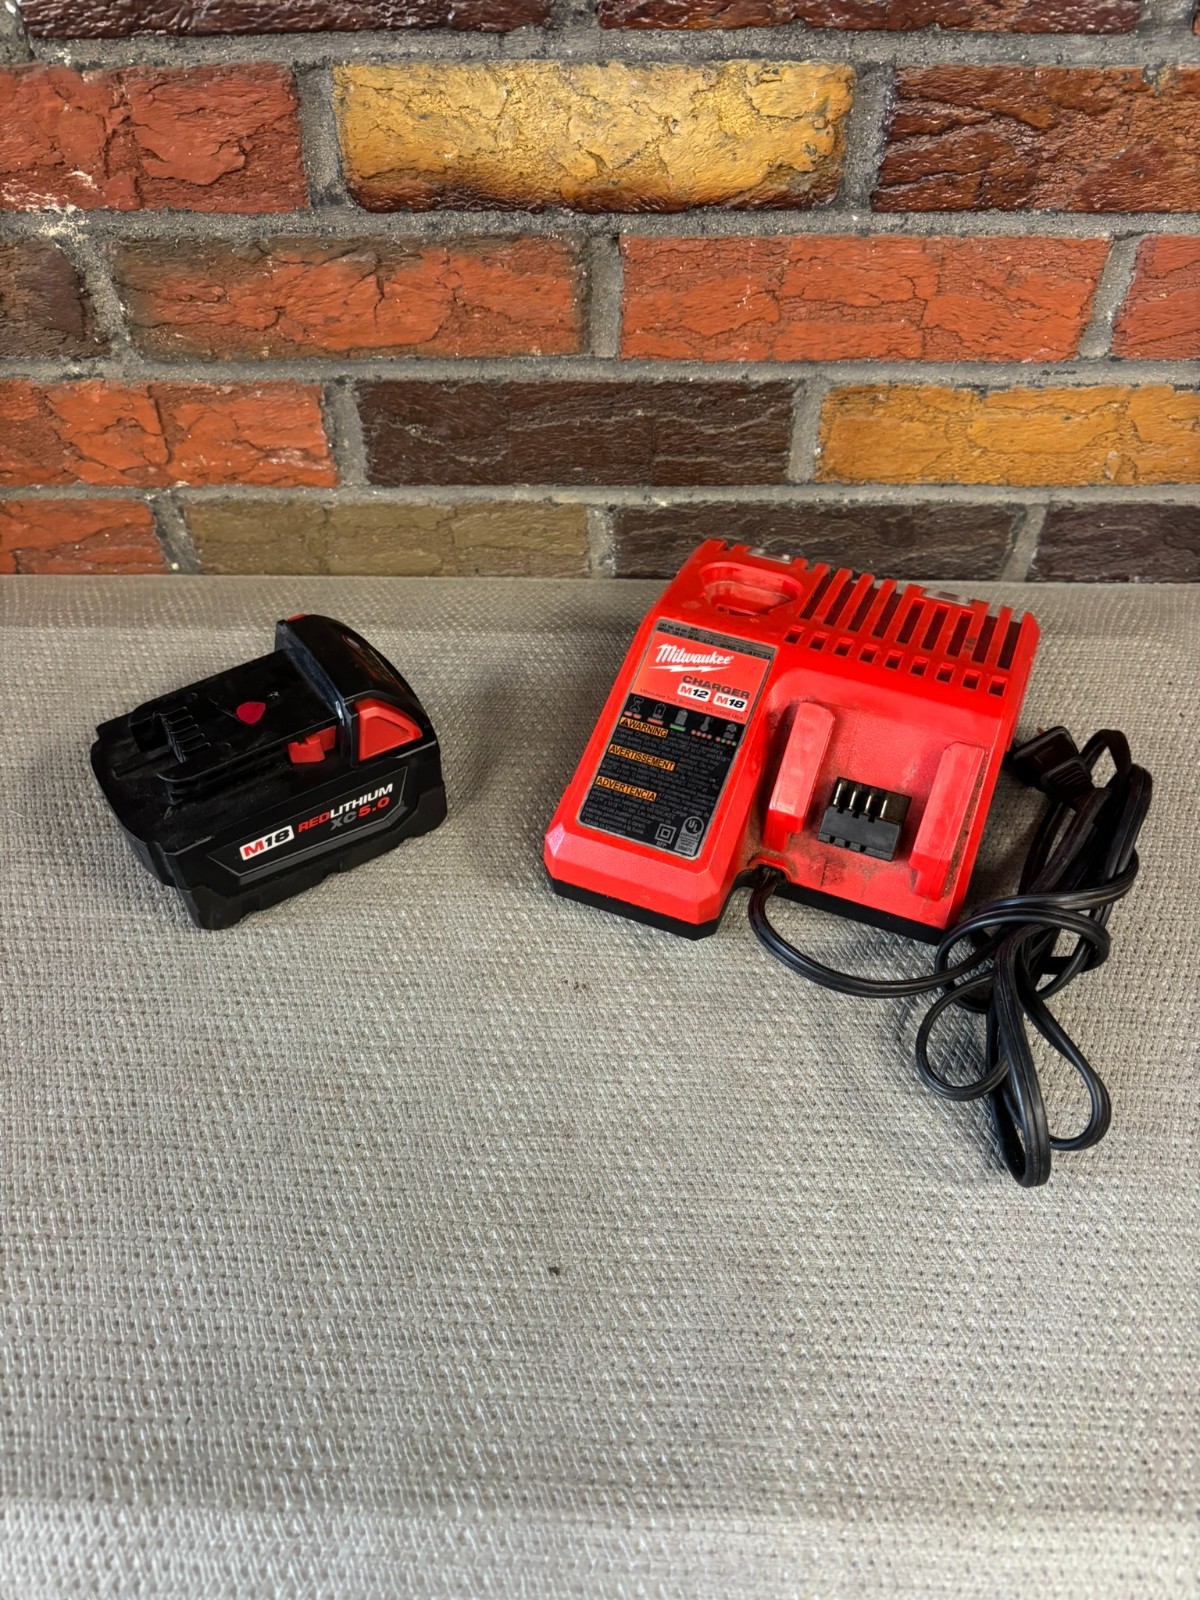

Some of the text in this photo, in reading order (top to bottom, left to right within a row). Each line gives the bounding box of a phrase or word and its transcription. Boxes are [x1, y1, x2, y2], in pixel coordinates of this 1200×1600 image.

[656, 643, 732, 665] Milwaukee
[680, 685, 746, 709] M12 M18
[682, 675, 751, 700] CHARGER
[629, 720, 668, 737] WARNING
[609, 746, 675, 771] AVERTISSEMENT
[596, 777, 656, 801] ADVERTENCIA
[298, 783, 394, 833] REDLITHIUM
[243, 828, 291, 858] M18
